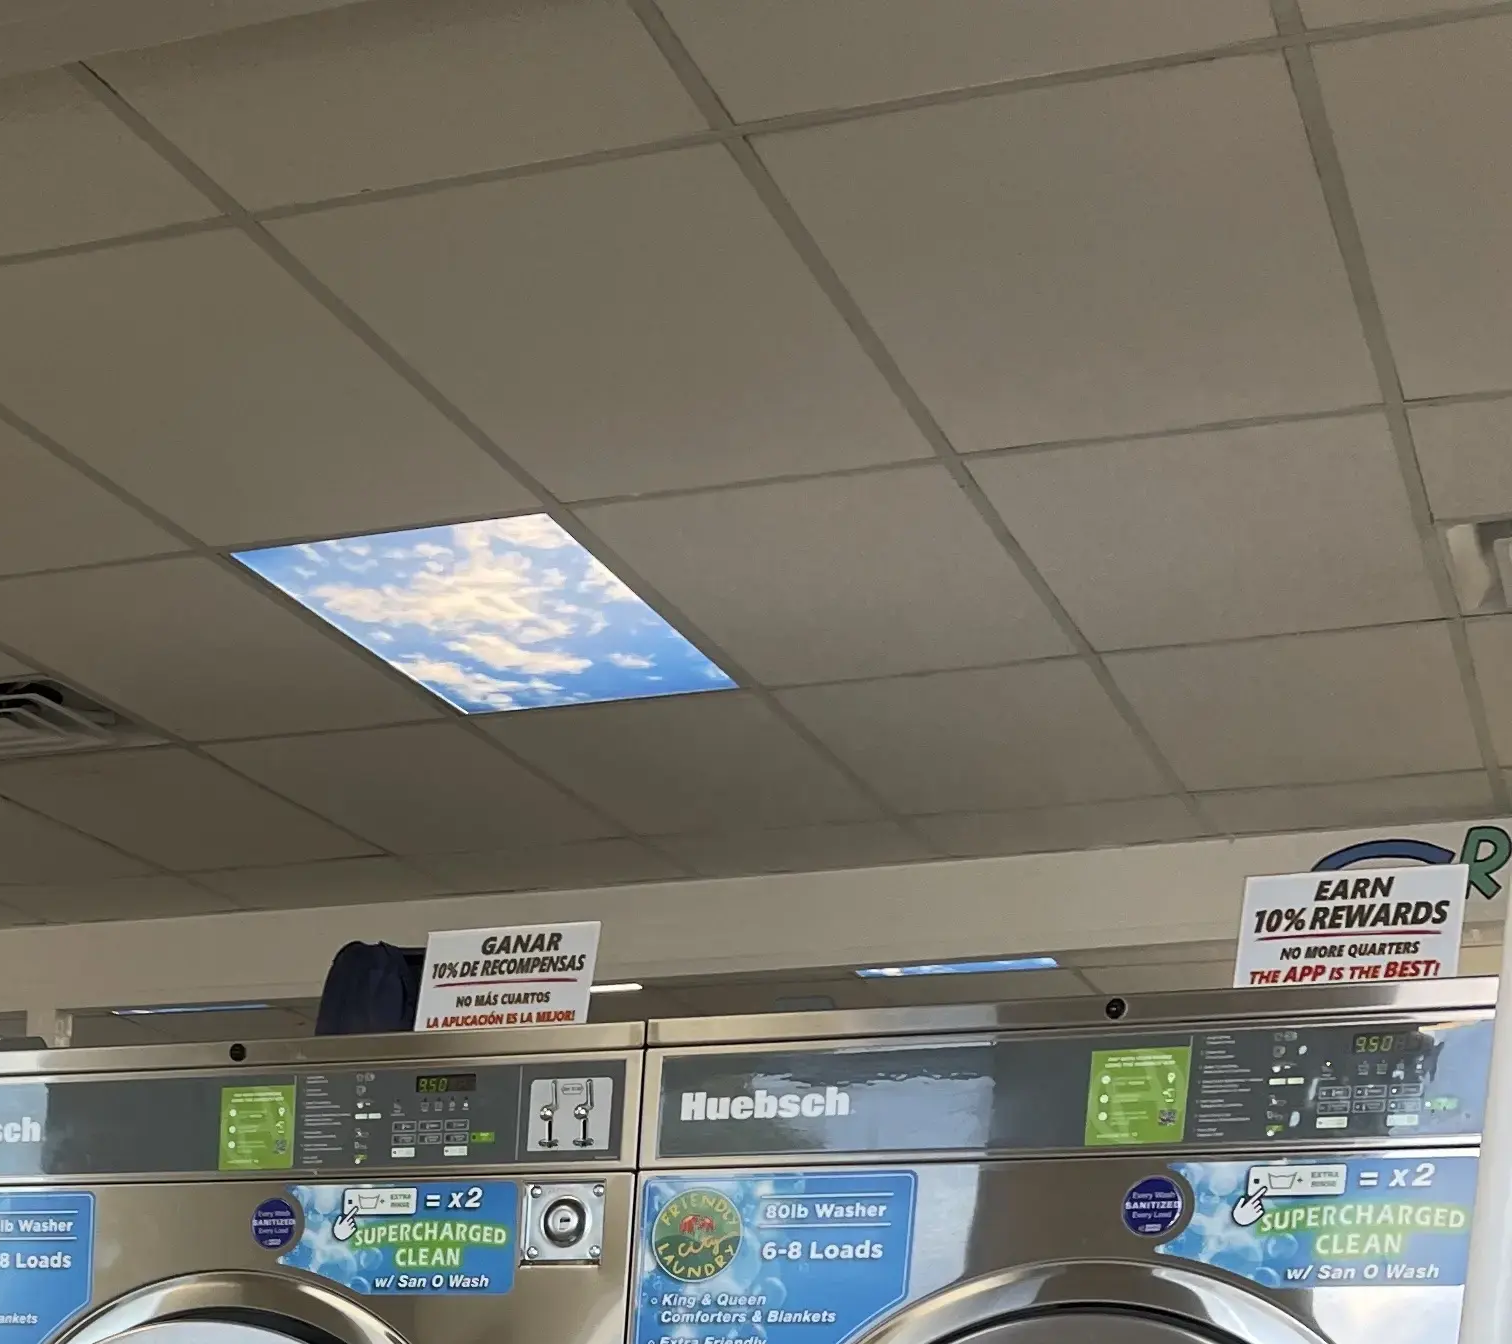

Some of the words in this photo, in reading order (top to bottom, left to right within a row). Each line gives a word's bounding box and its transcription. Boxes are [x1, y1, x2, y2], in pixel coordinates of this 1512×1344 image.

[1460, 825, 1512, 900] R
[1314, 876, 1395, 902] EARN
[1254, 907, 1307, 933] 10%
[1309, 900, 1450, 930] REWARDS
[481, 932, 563, 955] GANAR
[1279, 947, 1300, 960] NO
[1304, 944, 1344, 959] MORE
[1347, 941, 1420, 957] QUARTERS
[432, 961, 459, 979] 10%
[460, 958, 478, 976] DE
[480, 954, 586, 976] RECOMPENSAS
[1250, 969, 1281, 985] THE
[1283, 964, 1326, 983] APP
[1329, 967, 1343, 980] IS
[1349, 964, 1380, 979] THE
[1384, 959, 1441, 978] BEST!
[455, 995, 472, 1008] NO
[475, 991, 498, 1006] MÁS
[501, 991, 551, 1005] CUARTOS
[426, 1017, 438, 1028] LA
[441, 1010, 504, 1028] APLICACIÓN
[506, 1012, 517, 1024] ES
[520, 1012, 533, 1023] LA
[535, 1009, 575, 1022] MEJOR!
[681, 1086, 850, 1121] Huebsch
[1311, 1171, 1339, 1179] EXTRA
[1388, 1162, 1436, 1187] x2
[448, 1187, 483, 1208] x2
[1125, 1201, 1180, 1209] SANITIZED
[765, 1204, 808, 1219] 80lb
[815, 1203, 887, 1218] Washer
[1260, 1203, 1465, 1232] SUPERCHARGED
[18, 1219, 73, 1232] Washer
[354, 1222, 507, 1246] SUPERCHARGED
[762, 1241, 802, 1260] 6-8
[810, 1240, 883, 1259] Loads
[1315, 1233, 1403, 1254] CLEAN
[16, 1252, 72, 1268] Loads
[395, 1248, 460, 1267] CLEAN
[375, 1275, 393, 1288] w/
[398, 1275, 426, 1288] San
[432, 1275, 444, 1287] O
[449, 1274, 490, 1288] Wash
[1287, 1265, 1313, 1280] w/
[1317, 1265, 1355, 1279] San
[1364, 1264, 1379, 1279] O
[1386, 1264, 1439, 1279] Wash
[661, 1293, 696, 1308] King
[701, 1294, 711, 1305] &
[717, 1293, 766, 1306] Queen
[661, 1310, 746, 1323] Comforters
[752, 1311, 762, 1323] &
[767, 1310, 836, 1323] Blankets
